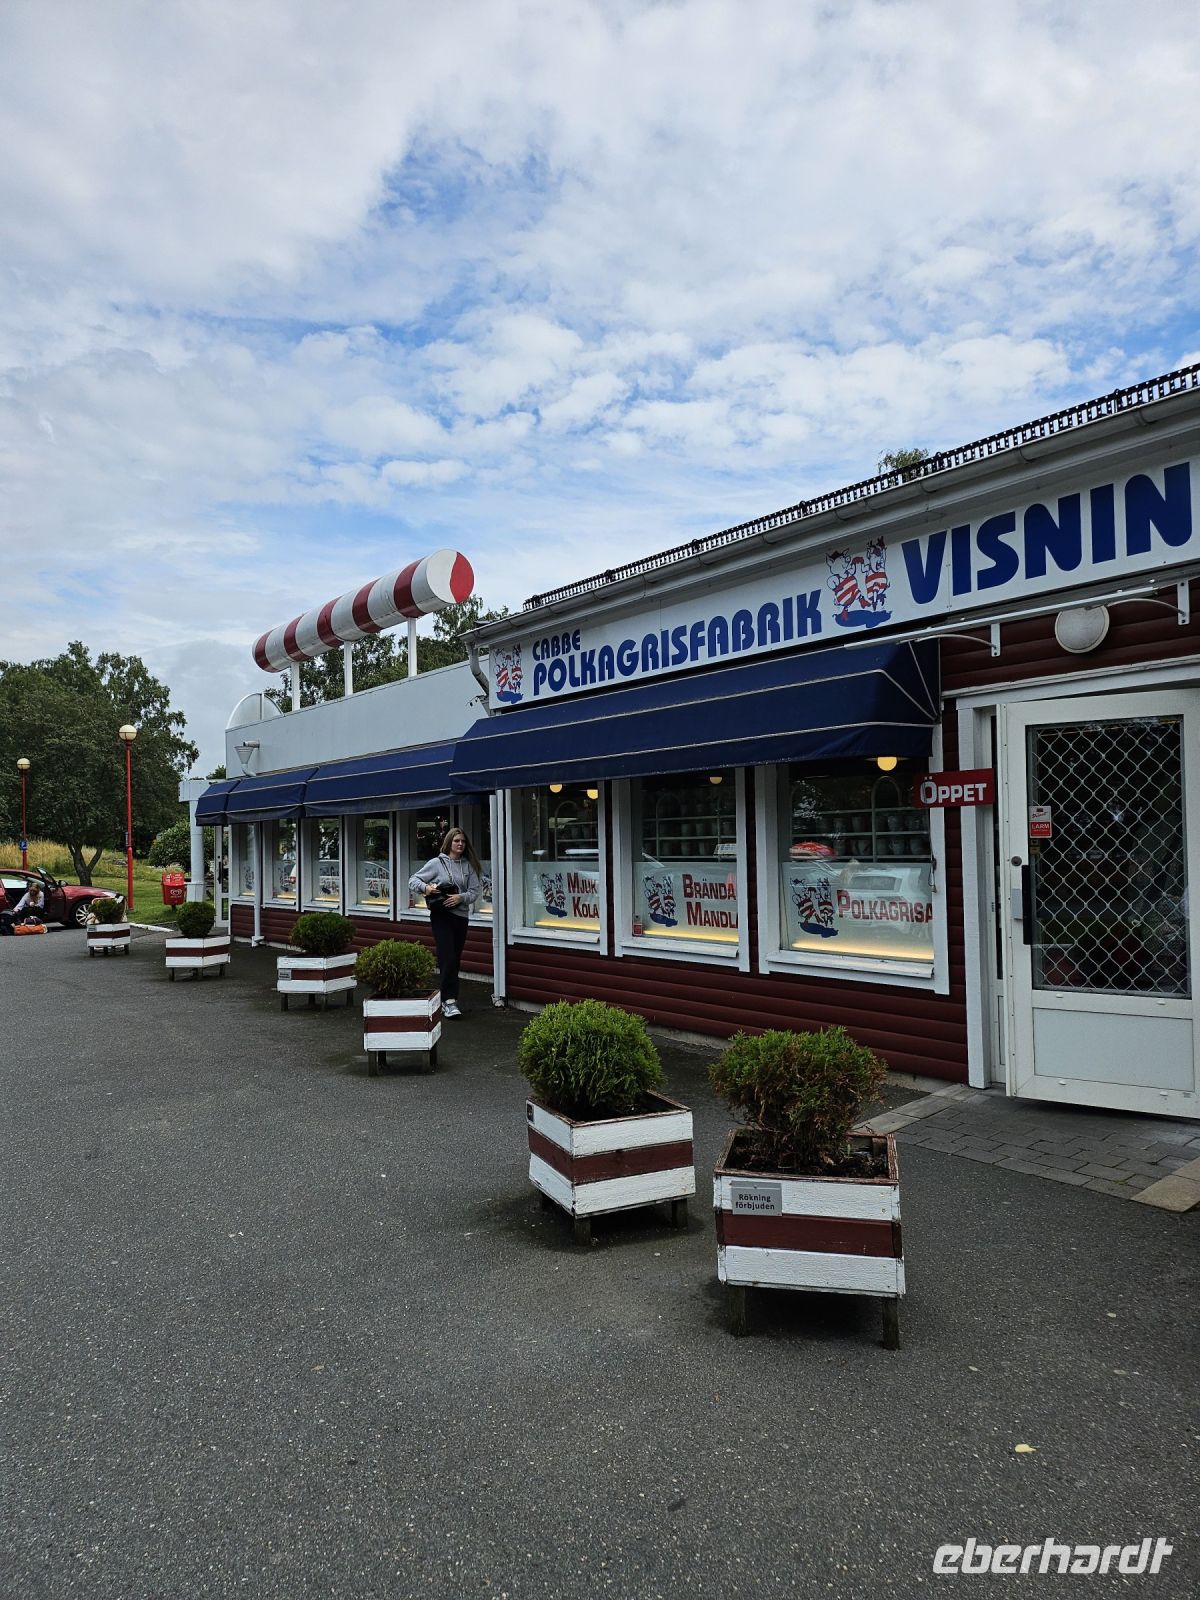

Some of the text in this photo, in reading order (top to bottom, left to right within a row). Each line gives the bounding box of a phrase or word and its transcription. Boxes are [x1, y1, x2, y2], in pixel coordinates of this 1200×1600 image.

[901, 462, 1193, 605] VISNIN
[532, 628, 582, 661] CABBE
[533, 589, 823, 697] POLKAGRISFABRIK
[920, 776, 987, 804] ÖPPET
[682, 873, 737, 900] BRÄNDA
[686, 901, 739, 929] MANDL
[735, 1201, 775, 1210] förbjuden
[738, 1193, 771, 1203] Rökning
